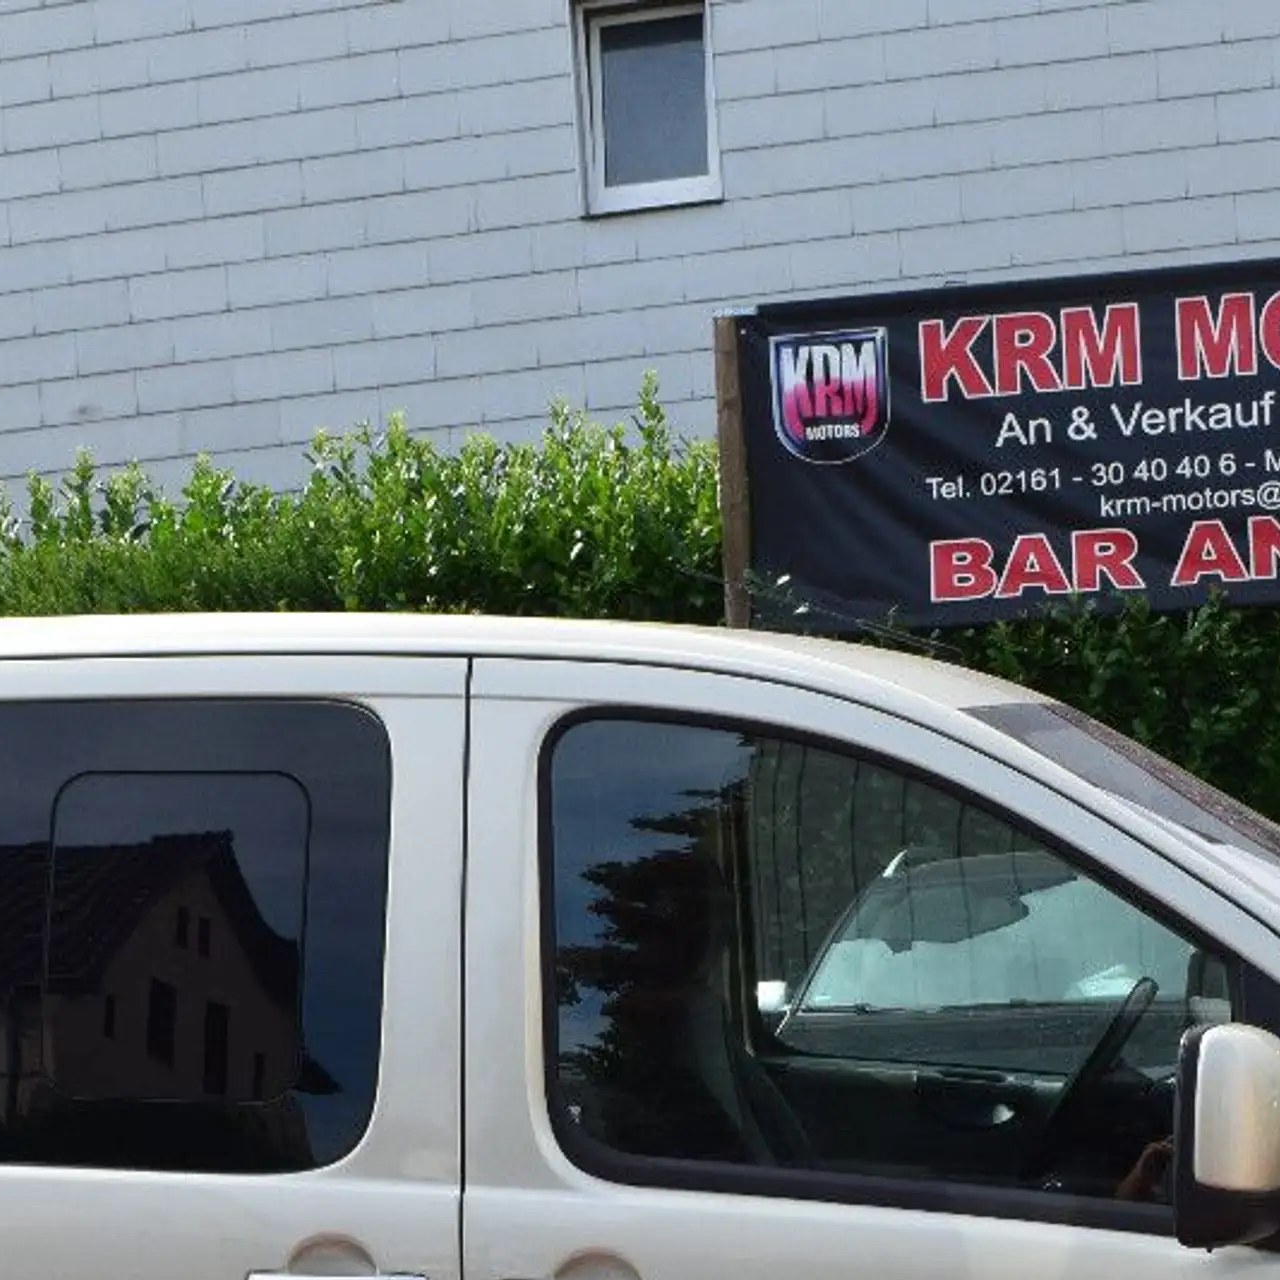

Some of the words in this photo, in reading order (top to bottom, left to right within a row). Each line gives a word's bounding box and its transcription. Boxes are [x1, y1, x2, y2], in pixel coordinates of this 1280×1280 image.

[918, 302, 1143, 403] KRM
[779, 341, 879, 443] KRM
[995, 412, 1053, 447] An
[1067, 406, 1098, 441] &
[1110, 390, 1276, 437] Verkauf
[925, 476, 970, 499] Tel.
[980, 467, 1061, 496] 02161
[1090, 462, 1124, 486] 30
[1133, 458, 1167, 482] 40
[1176, 455, 1210, 478] 40
[1219, 453, 1236, 476] 6
[929, 527, 1146, 603] BAR
